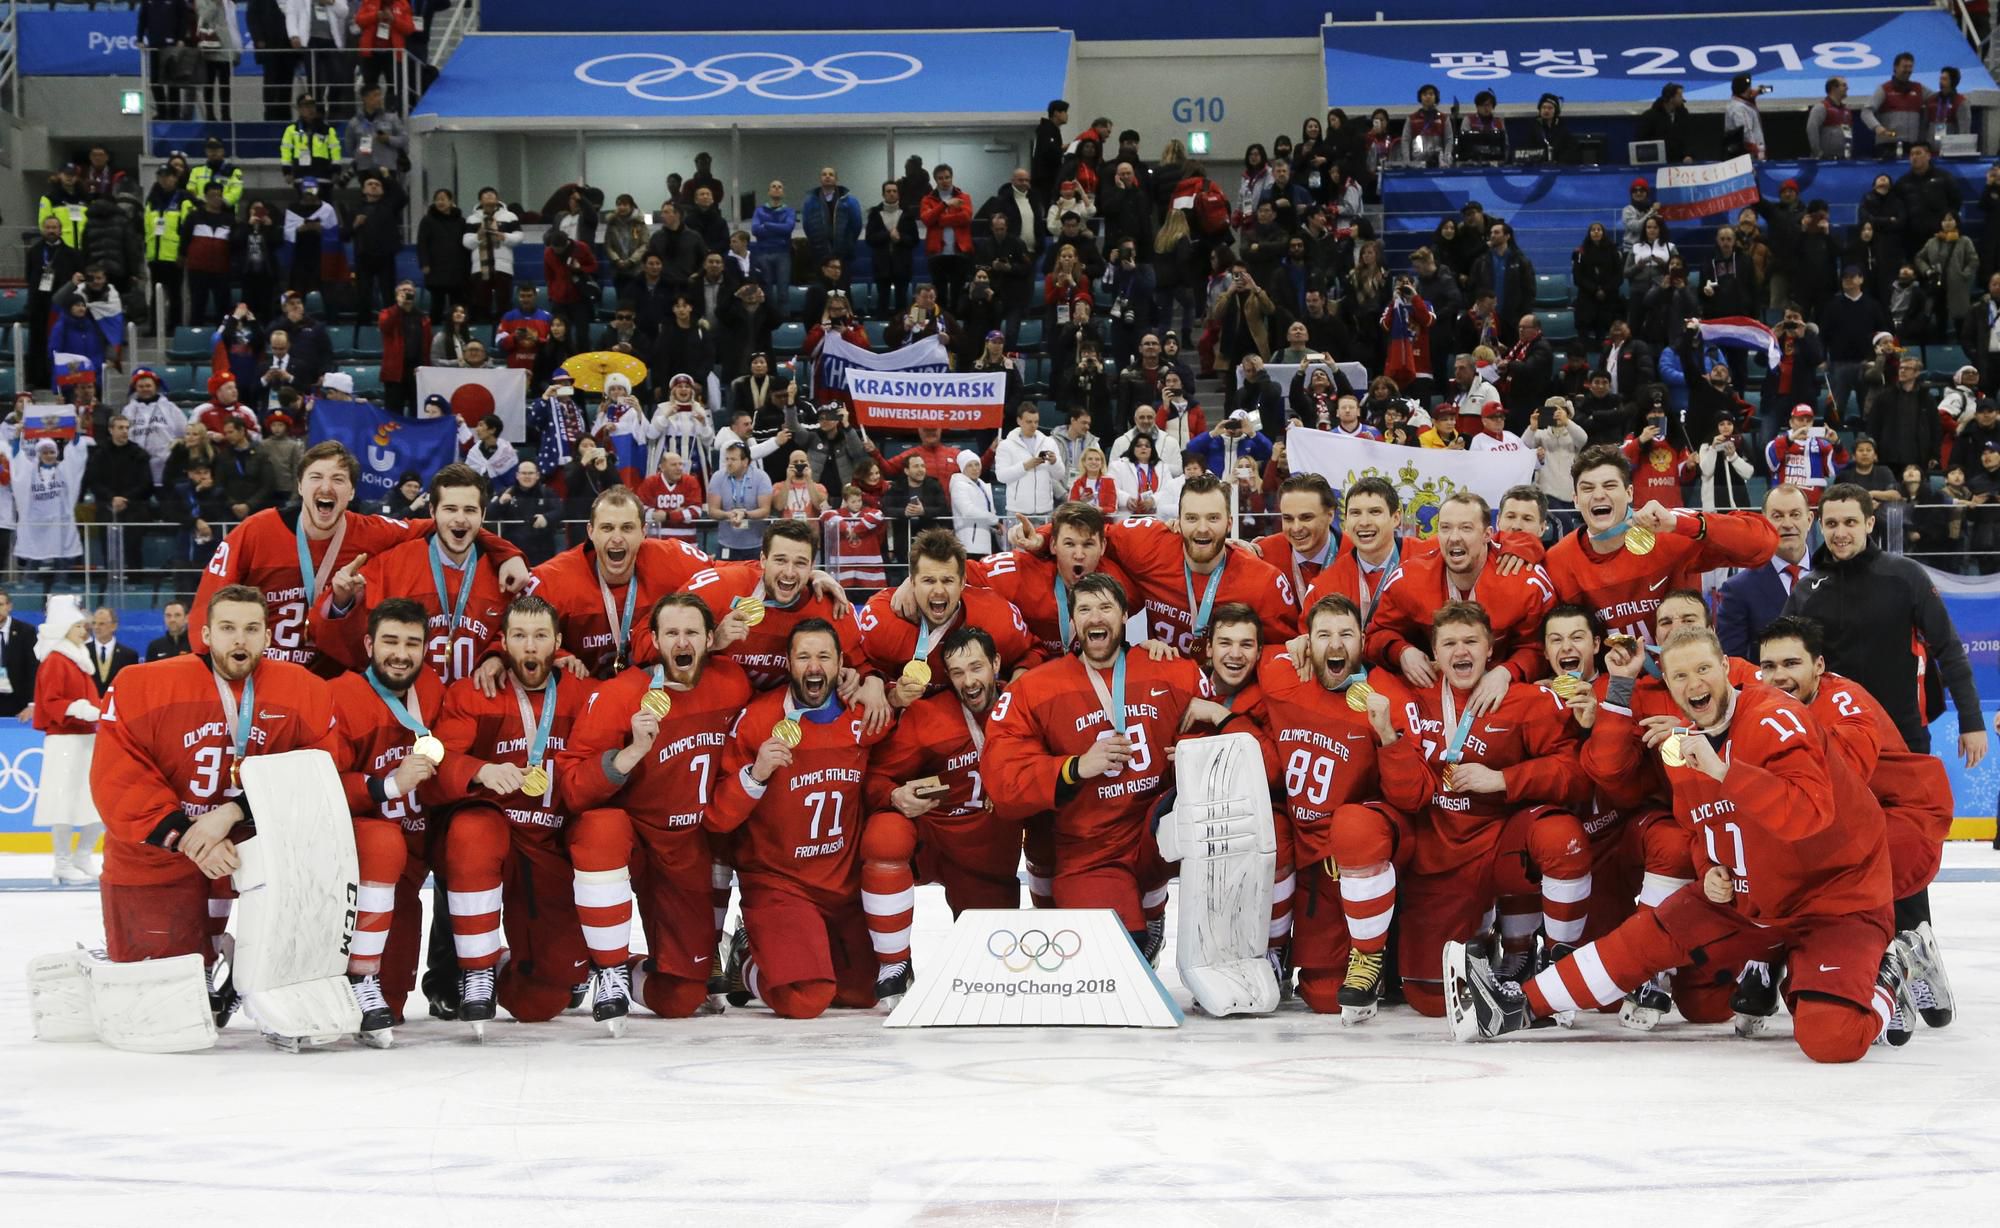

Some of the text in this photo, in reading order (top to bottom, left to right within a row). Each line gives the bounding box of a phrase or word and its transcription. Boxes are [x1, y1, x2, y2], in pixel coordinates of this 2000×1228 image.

[1431, 42, 1882, 80] 평창 2018
[1172, 97, 1224, 123] G10
[853, 378, 995, 399] KRASNOYARSK
[867, 406, 982, 421] UNIVERSIADE-2019
[209, 541, 229, 577] 21
[266, 586, 306, 602] OLYMPI
[1145, 598, 1177, 619] OLYMPIC
[583, 633, 616, 649] OLYMP
[731, 653, 773, 666] OLYMPIC
[1832, 691, 1862, 717] 2
[1076, 709, 1109, 732] OLYMPI
[1759, 708, 1807, 743] 11
[183, 721, 225, 749] OLYMPIC
[496, 737, 527, 755] OLYMP
[1280, 728, 1350, 763] OLYMPIC ATHLETE
[659, 735, 695, 764] OLYMPIC
[947, 751, 981, 771] OLYMPI
[690, 753, 710, 804] 7
[825, 767, 861, 784] ATHLETE
[1285, 748, 1336, 805] 89
[1098, 783, 1125, 799] FROM
[669, 812, 697, 827] FROM
[804, 790, 843, 840] 71
[1296, 806, 1331, 822] RUSS
[1583, 809, 1619, 834] RUSSIA
[795, 845, 820, 858] FROM
[339, 881, 358, 957] CCM
[952, 978, 1116, 997] PyeongChang 2018
